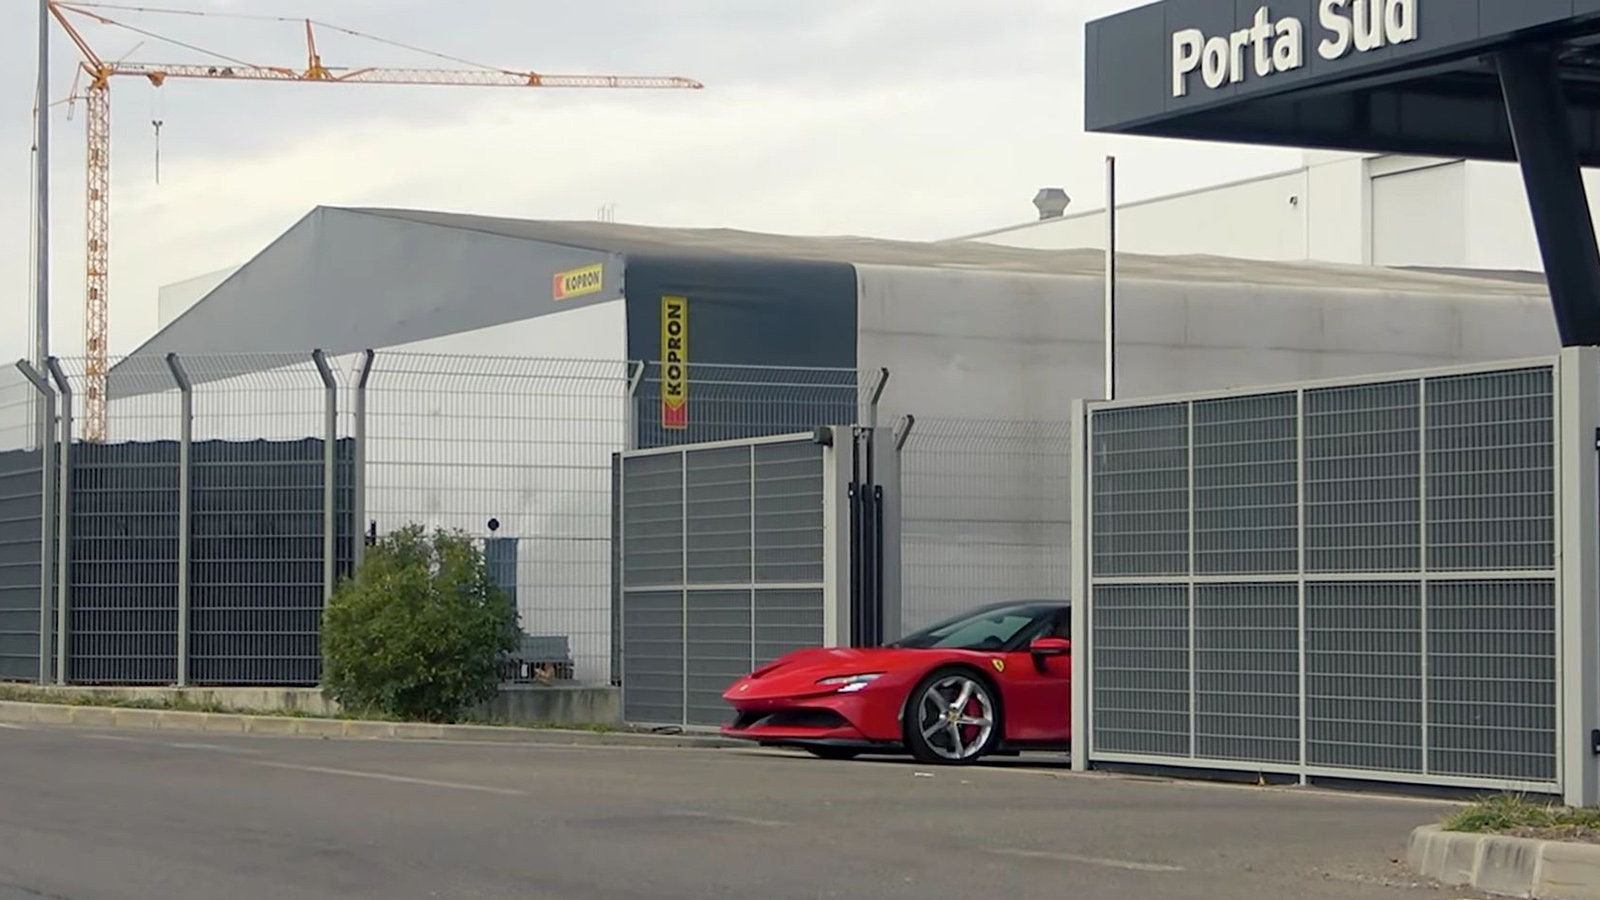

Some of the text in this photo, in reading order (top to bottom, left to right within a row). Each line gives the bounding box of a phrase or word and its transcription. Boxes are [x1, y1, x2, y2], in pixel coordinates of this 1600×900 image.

[1172, 0, 1418, 97] Porta Sud
[565, 270, 600, 291] KOPRON
[667, 303, 681, 396] KOPRON
